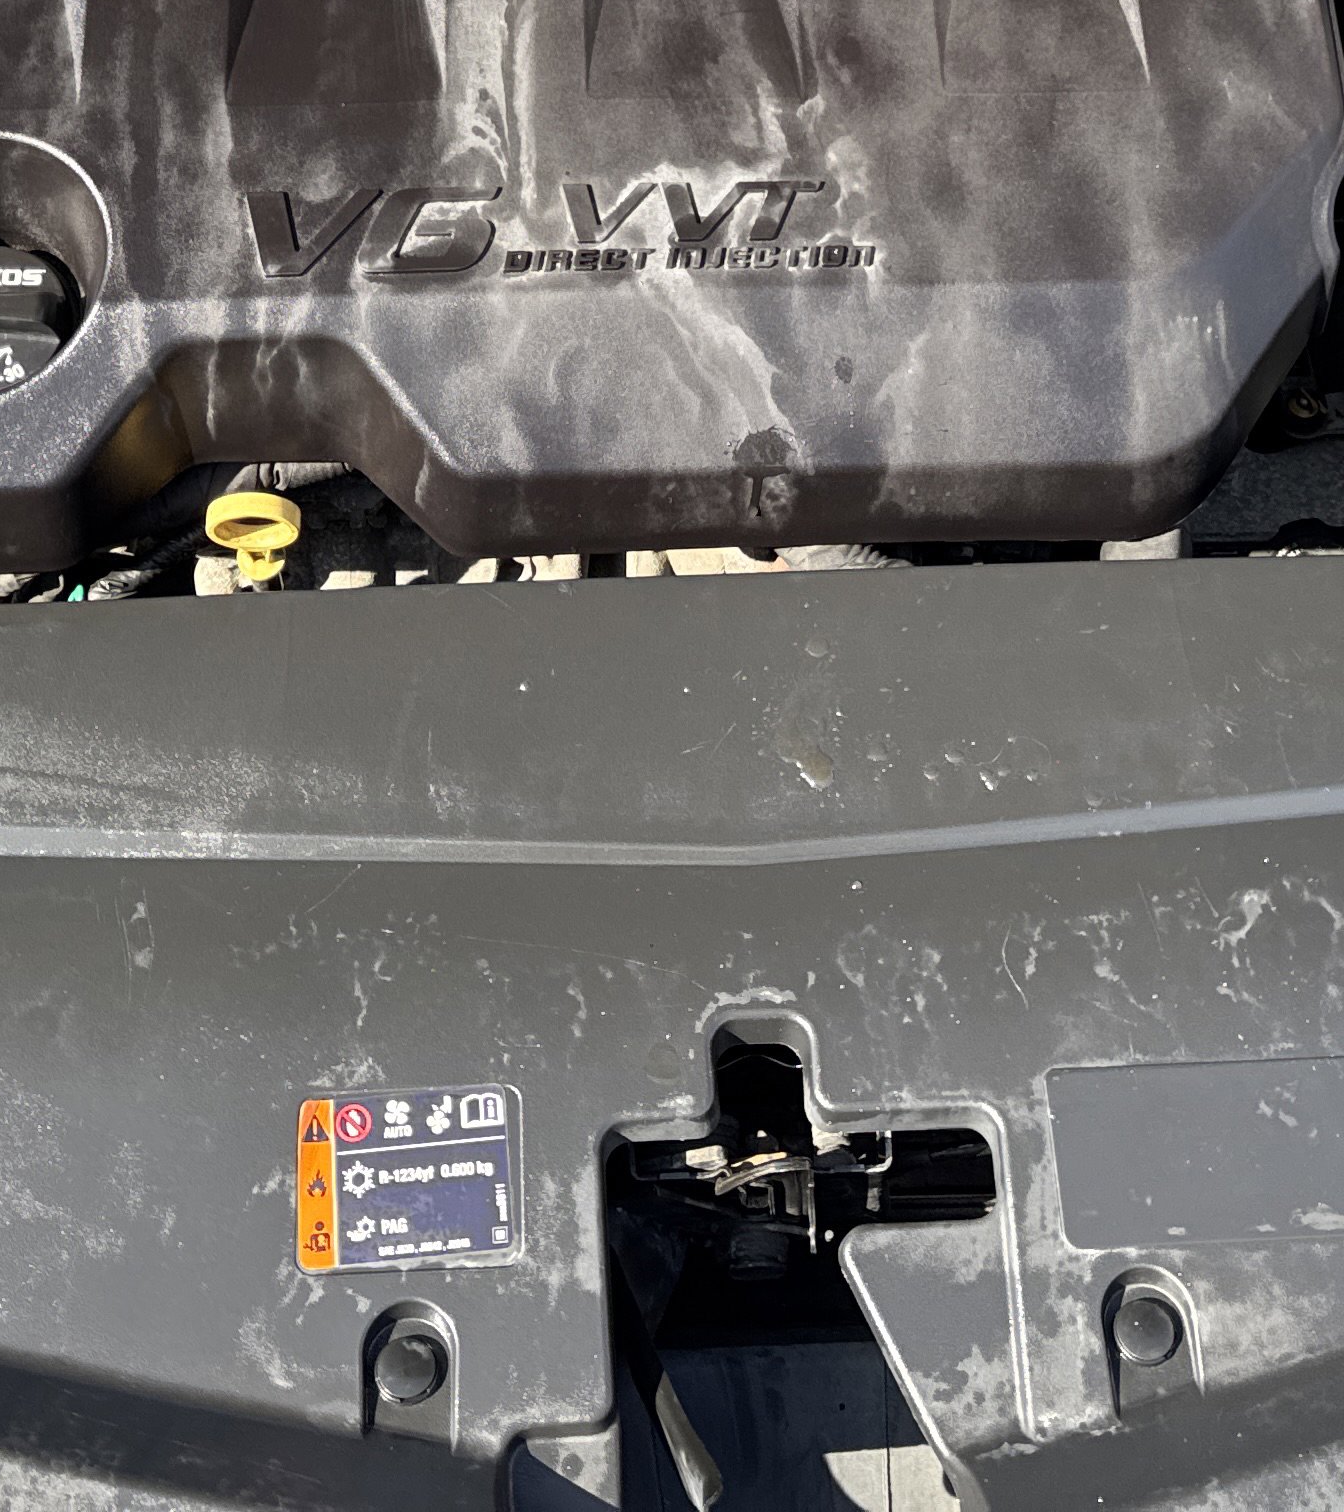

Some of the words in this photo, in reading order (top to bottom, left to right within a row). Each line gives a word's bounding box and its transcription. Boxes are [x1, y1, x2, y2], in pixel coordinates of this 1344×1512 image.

[247, 186, 503, 278] V6
[561, 180, 826, 245] VVT
[503, 248, 656, 274] DIRECT
[665, 244, 876, 270] INJECTION
[383, 1124, 413, 1139] AUTO
[475, 1160, 495, 1177] kg
[380, 1217, 409, 1235] PAG
